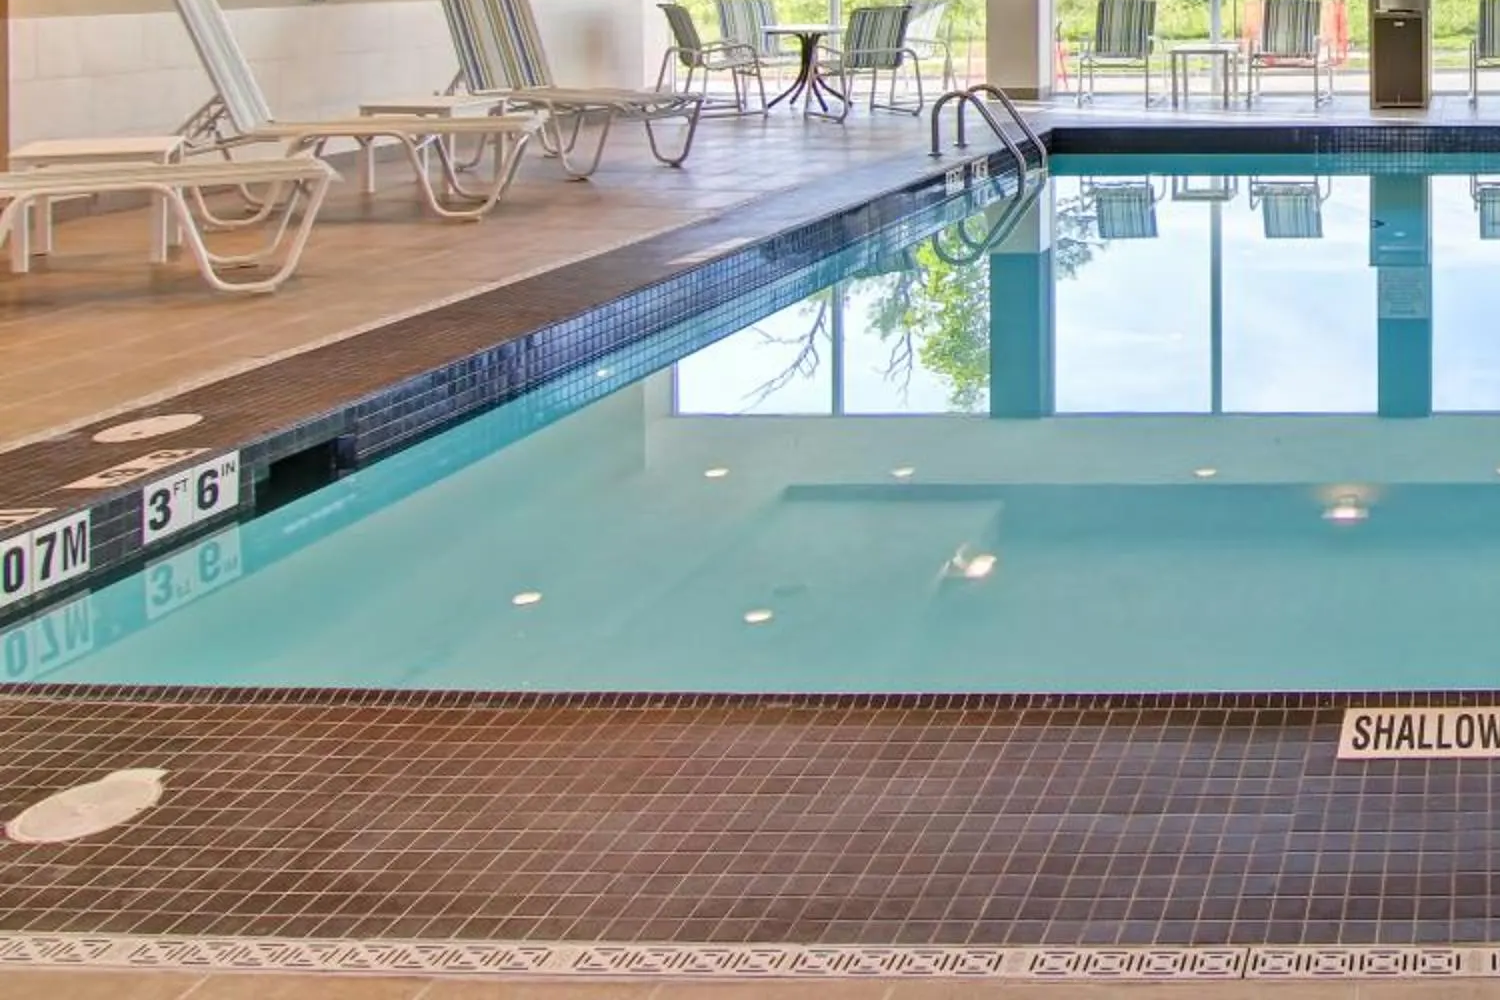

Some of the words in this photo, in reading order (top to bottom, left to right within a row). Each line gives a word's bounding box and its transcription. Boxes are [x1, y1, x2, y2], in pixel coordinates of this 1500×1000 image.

[149, 488, 172, 531] 3
[173, 478, 189, 495] FT
[198, 469, 219, 510] 6
[221, 460, 236, 477] IN
